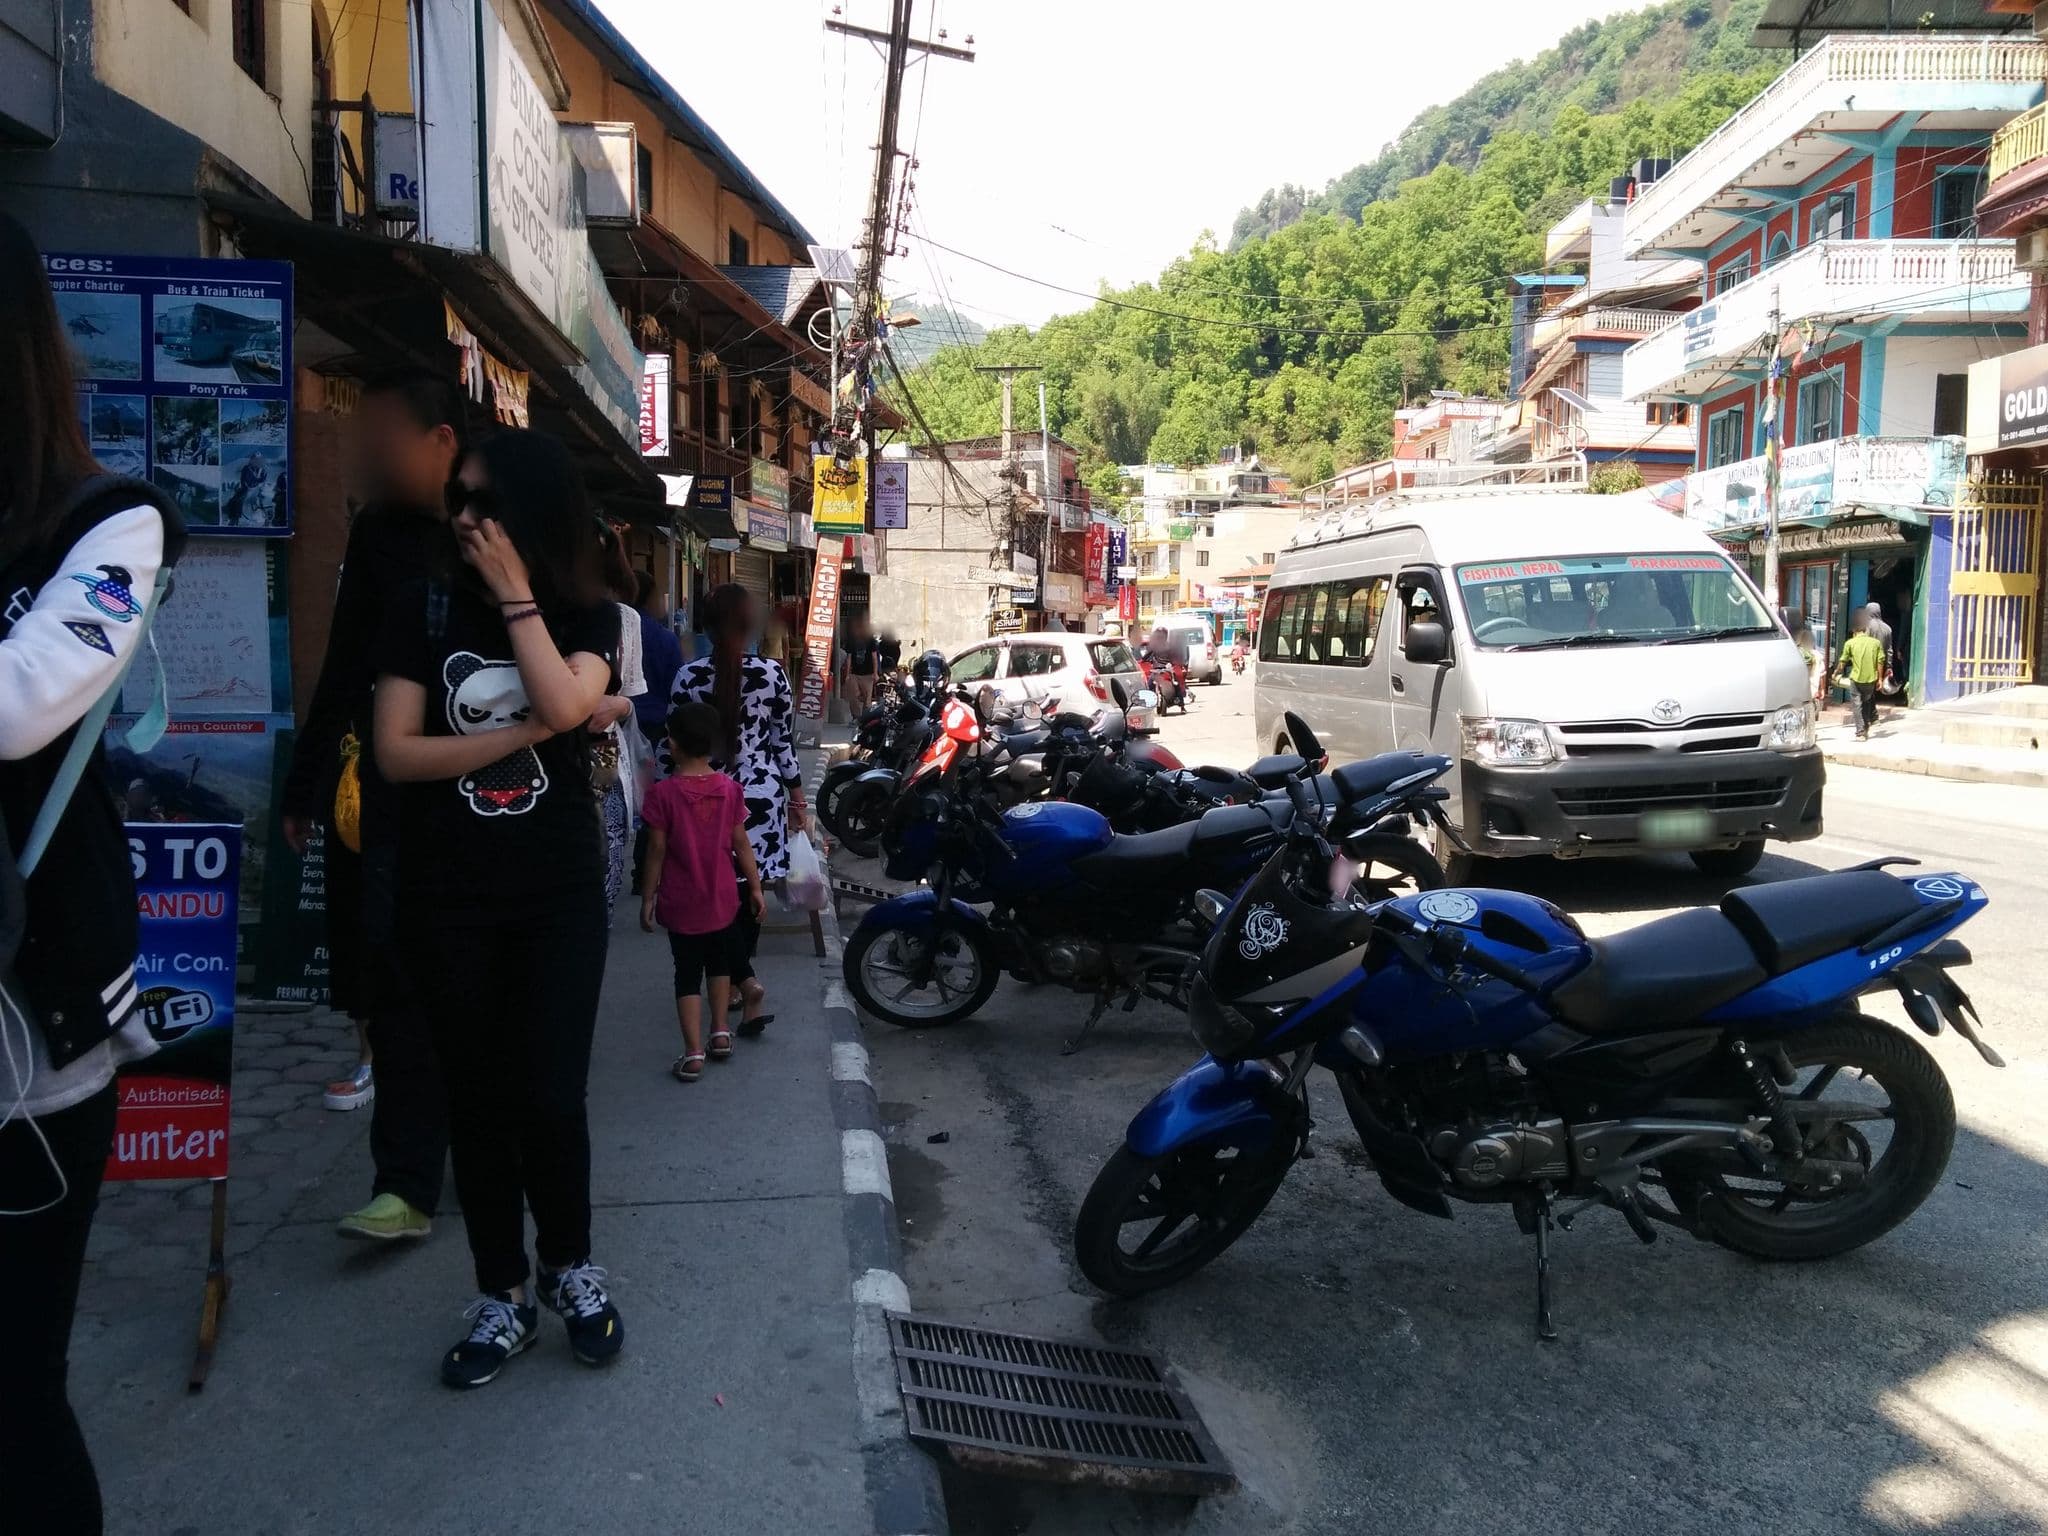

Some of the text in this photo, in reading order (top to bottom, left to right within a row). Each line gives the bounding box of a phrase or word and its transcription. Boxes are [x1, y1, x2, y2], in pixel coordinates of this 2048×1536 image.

[508, 55, 551, 160] BIMAL
[512, 127, 551, 217] COLD
[389, 172, 418, 201] Re
[512, 187, 555, 278] STORE
[43, 254, 113, 273] ices:
[84, 280, 125, 292] Charter
[167, 284, 265, 299] Bus & Train Ticket
[189, 384, 249, 397] Pony Trek
[640, 375, 653, 444] ENTRANCE
[2004, 386, 2048, 423] GOLD
[1727, 465, 1760, 484] MOUNTAIN
[1463, 566, 1519, 582] FISHTAIL
[1523, 561, 1564, 576] NEPAL
[202, 721, 254, 732] Counter
[164, 838, 228, 880] TO
[137, 891, 225, 919] ANDU
[135, 952, 230, 973] Air Con.
[125, 1085, 225, 1104] Authorised:
[118, 1123, 225, 1162] unter
